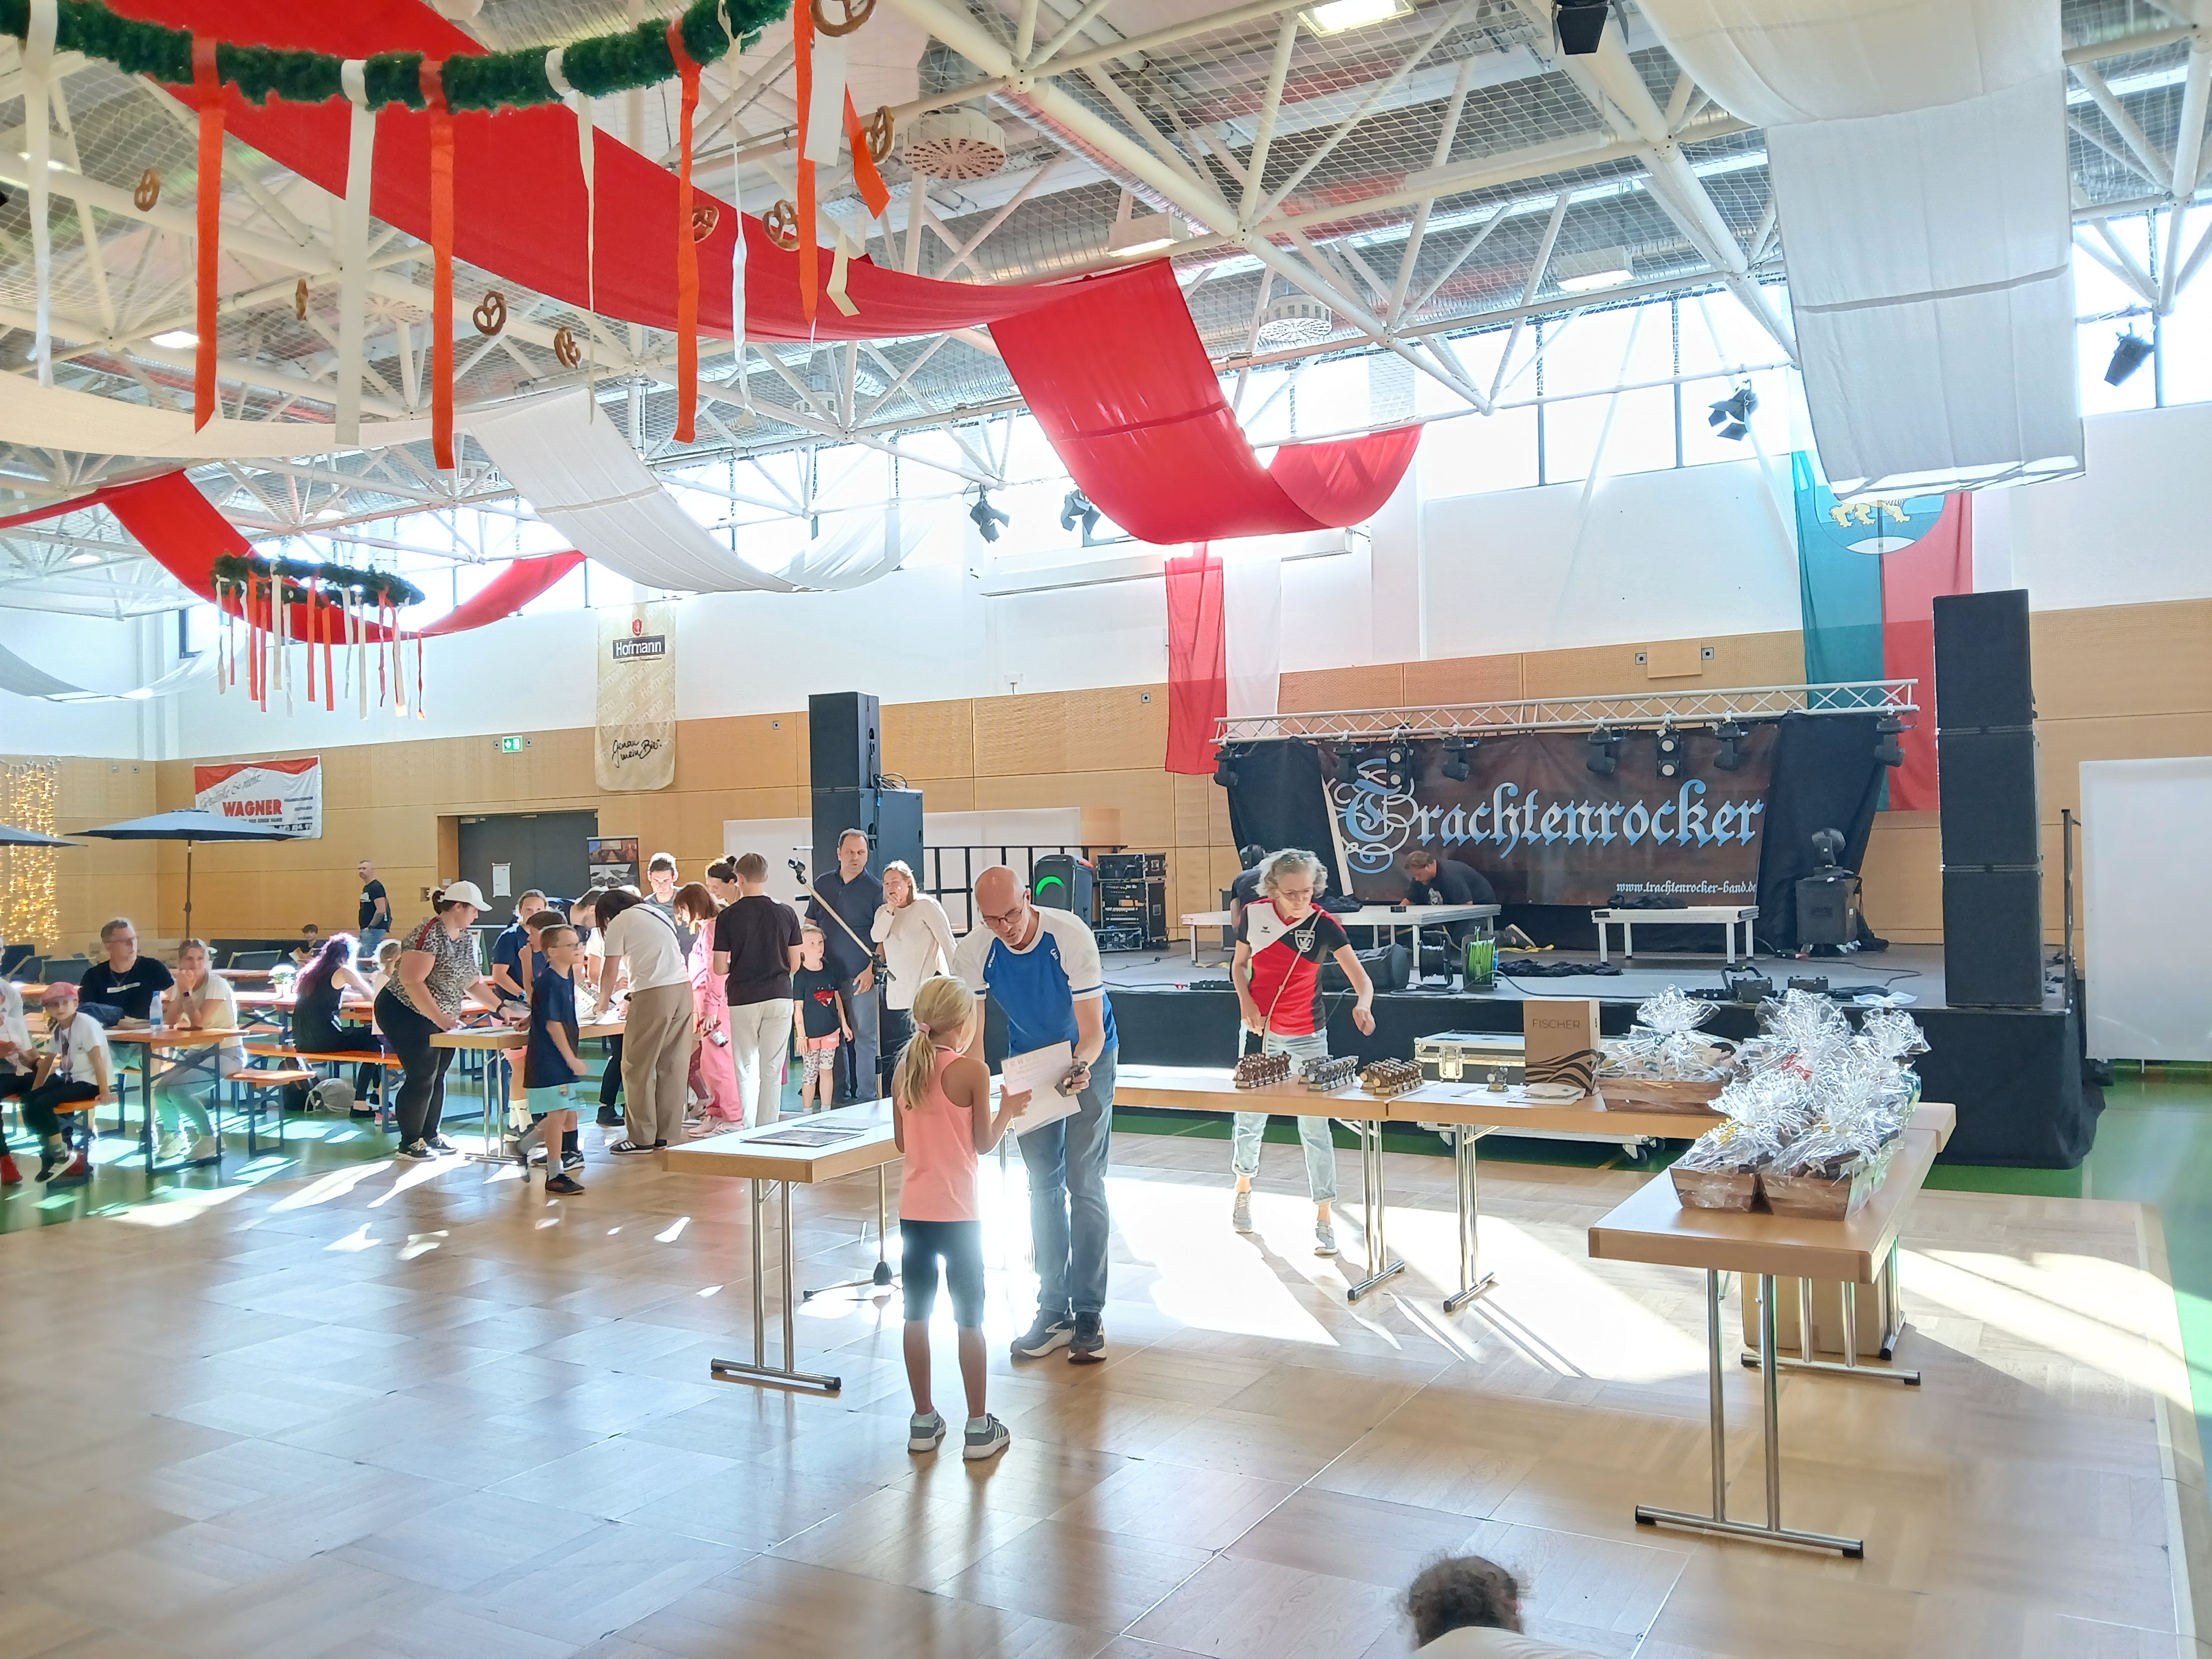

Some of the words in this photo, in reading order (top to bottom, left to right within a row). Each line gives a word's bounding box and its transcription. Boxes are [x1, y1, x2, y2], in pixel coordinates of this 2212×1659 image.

[615, 640, 662, 657] Hofmann
[620, 749, 641, 761] mein
[222, 799, 282, 817] WAGNER
[1327, 758, 1765, 874] Trachtenrocker
[1532, 1018, 1580, 1030] FISCHER
